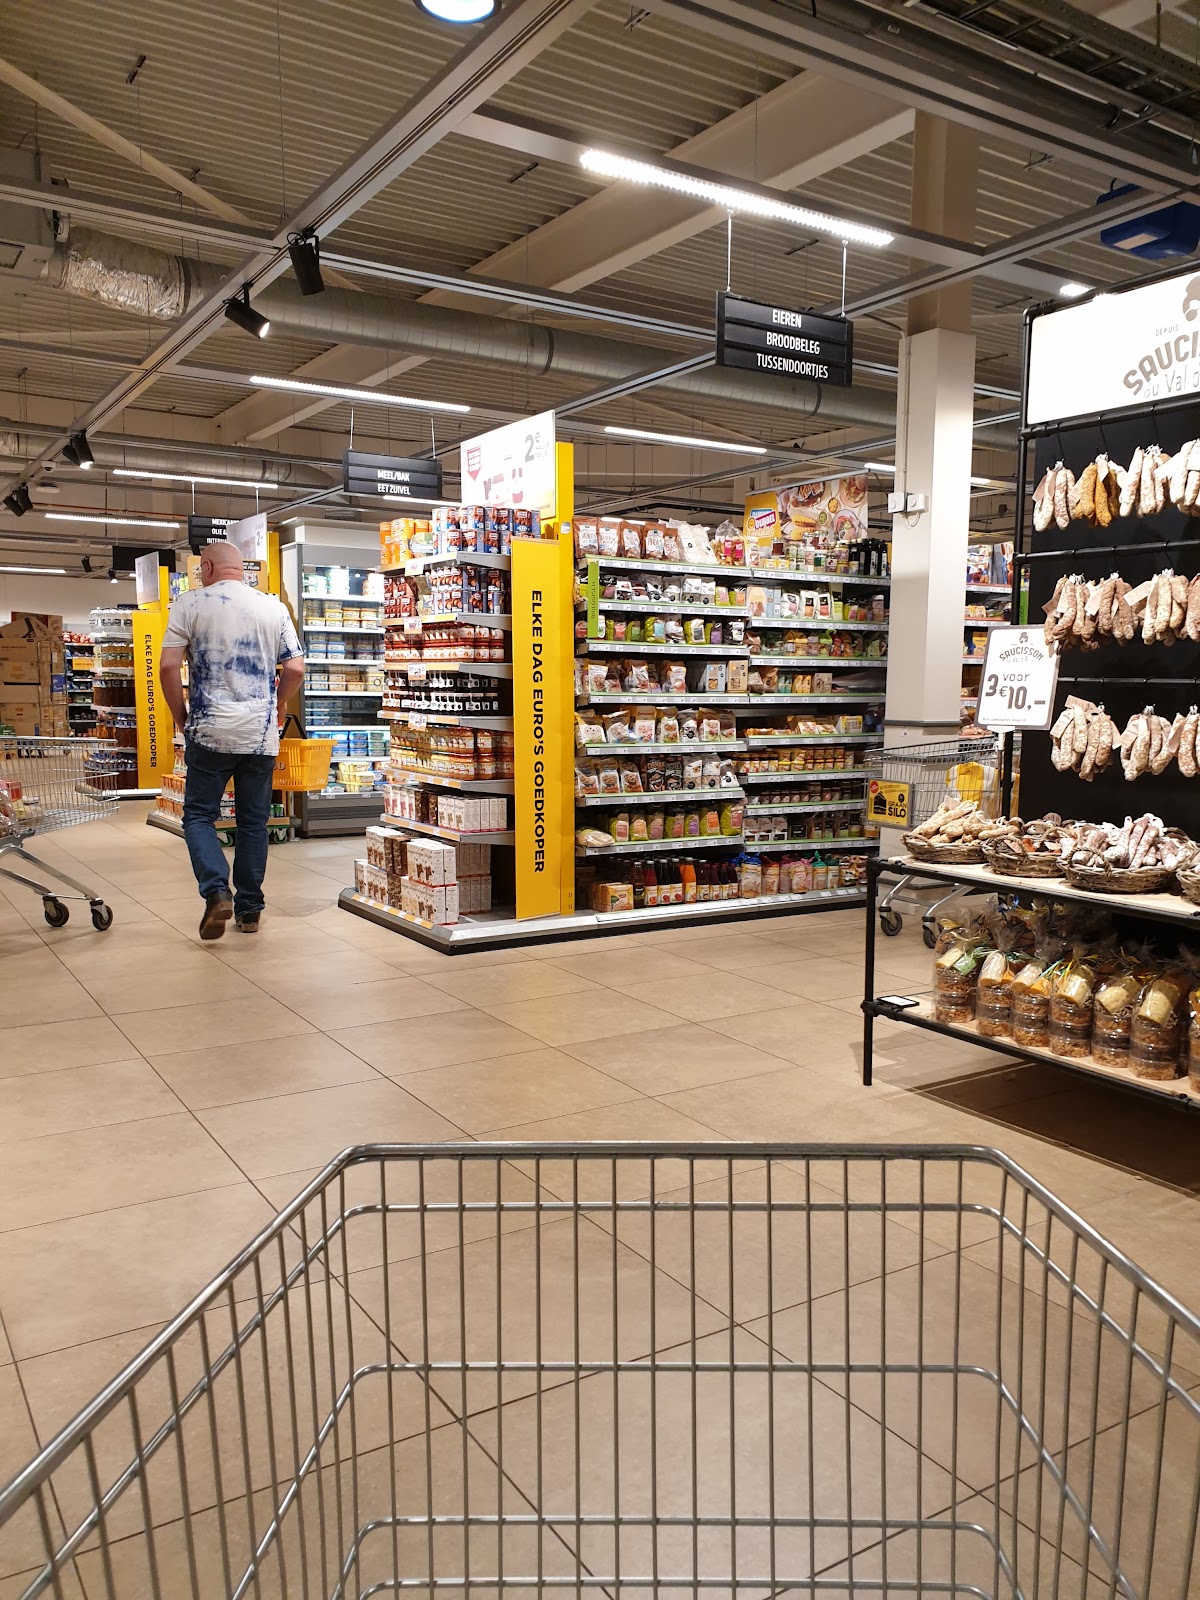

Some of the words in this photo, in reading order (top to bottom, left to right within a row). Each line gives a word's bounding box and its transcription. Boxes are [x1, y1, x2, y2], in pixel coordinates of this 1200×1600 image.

[772, 309, 802, 328] EIEREN
[1155, 324, 1179, 337] DEPUIS
[766, 332, 821, 355] BROODBELEG
[756, 353, 829, 379] TUSSENDOORTJES
[1123, 331, 1200, 396] SAUCI
[1165, 365, 1188, 393] Val
[377, 469, 411, 482] MEEL/BAK
[389, 485, 411, 496] ZUIVEL
[755, 513, 776, 529] DUBBEL
[532, 589, 542, 637] ELKE
[144, 634, 152, 657] ELKE
[999, 646, 1045, 662] SAUCISSON
[532, 643, 543, 683] DAG
[146, 680, 155, 712] EURO'S
[985, 673, 999, 697] 3
[1002, 673, 1031, 682] voor
[533, 689, 544, 757] EURO'S
[148, 713, 157, 768] GOEDKOPER
[533, 760, 544, 873] GOEDKOPER
[888, 806, 907, 818] SILO
